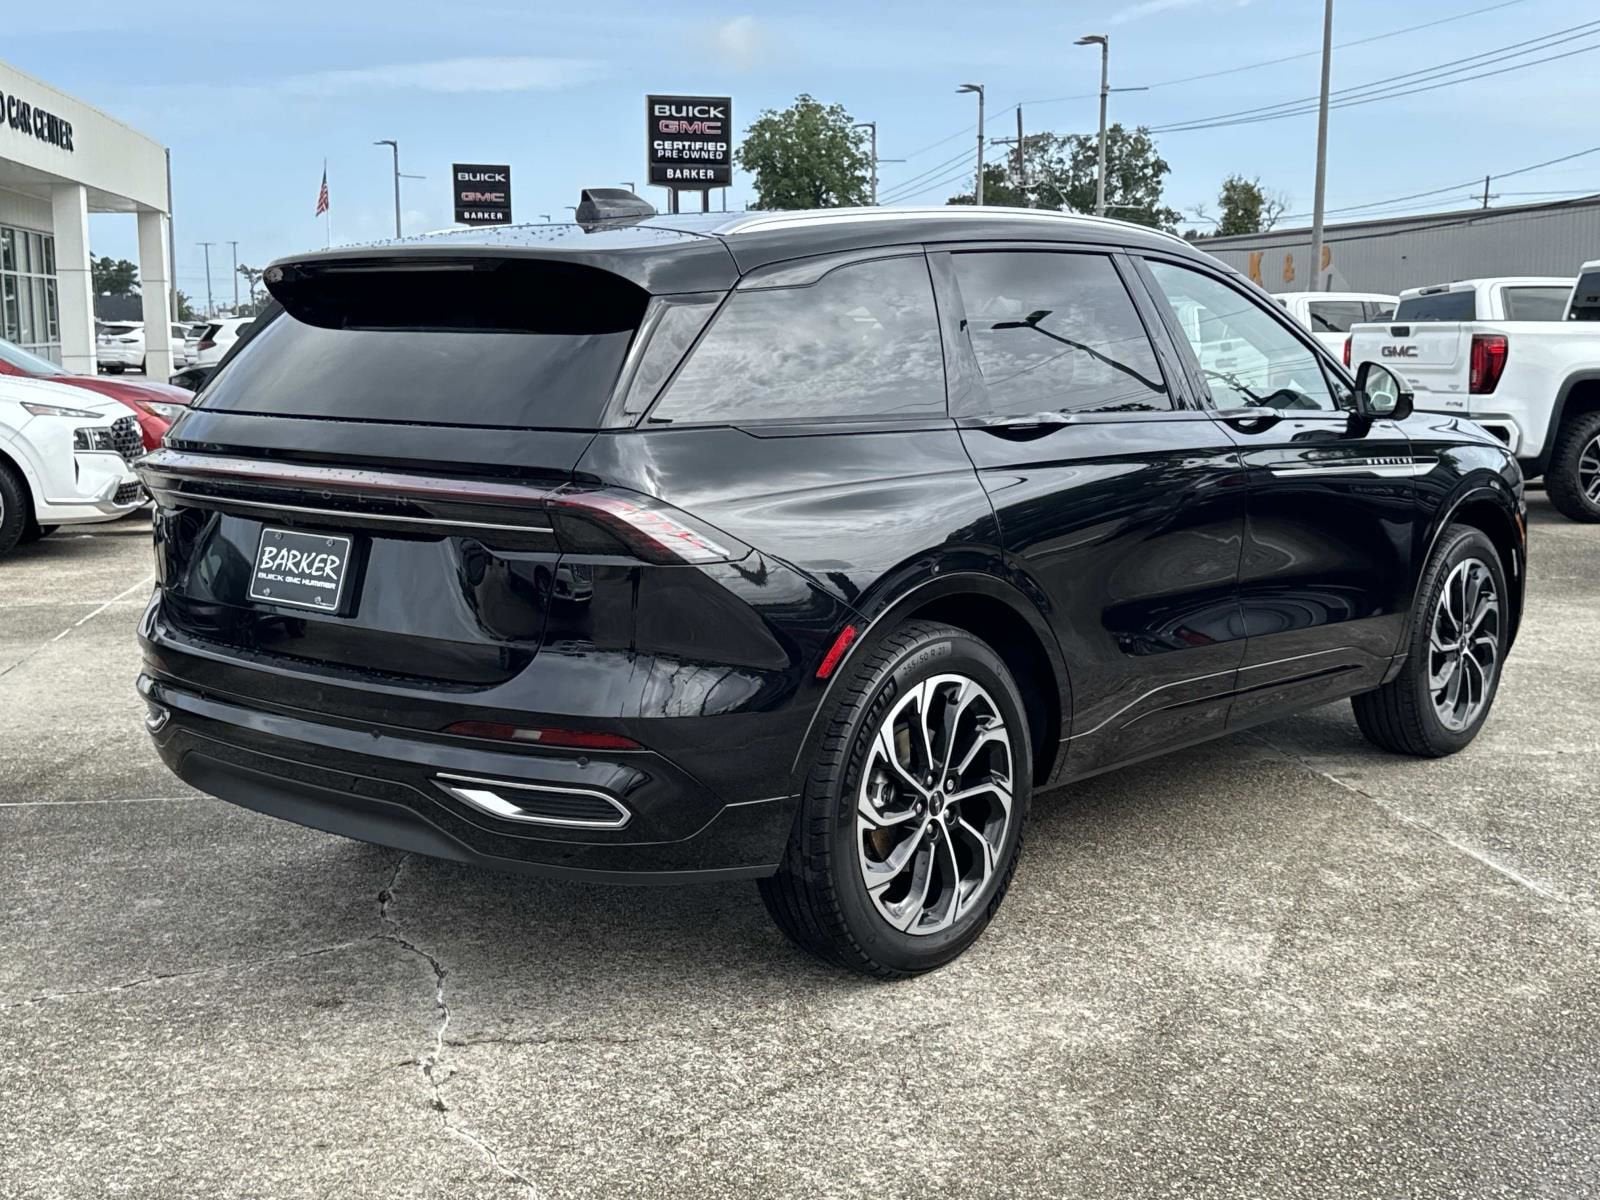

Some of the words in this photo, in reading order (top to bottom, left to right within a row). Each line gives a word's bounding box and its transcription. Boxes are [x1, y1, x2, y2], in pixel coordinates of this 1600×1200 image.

[654, 104, 726, 119] BUICK
[7, 95, 32, 136] CAR
[33, 107, 74, 152] CENTER
[659, 120, 722, 135] GMC
[653, 140, 727, 151] CERTIFIED
[657, 150, 724, 160] PRE-OWNED
[457, 172, 507, 182] BUICK
[666, 168, 715, 180] BARKER
[461, 191, 505, 203] GMC
[463, 211, 504, 221] BARKER
[1381, 345, 1419, 358] GMC
[260, 546, 340, 580] BARKER
[258, 572, 284, 581] BUICK
